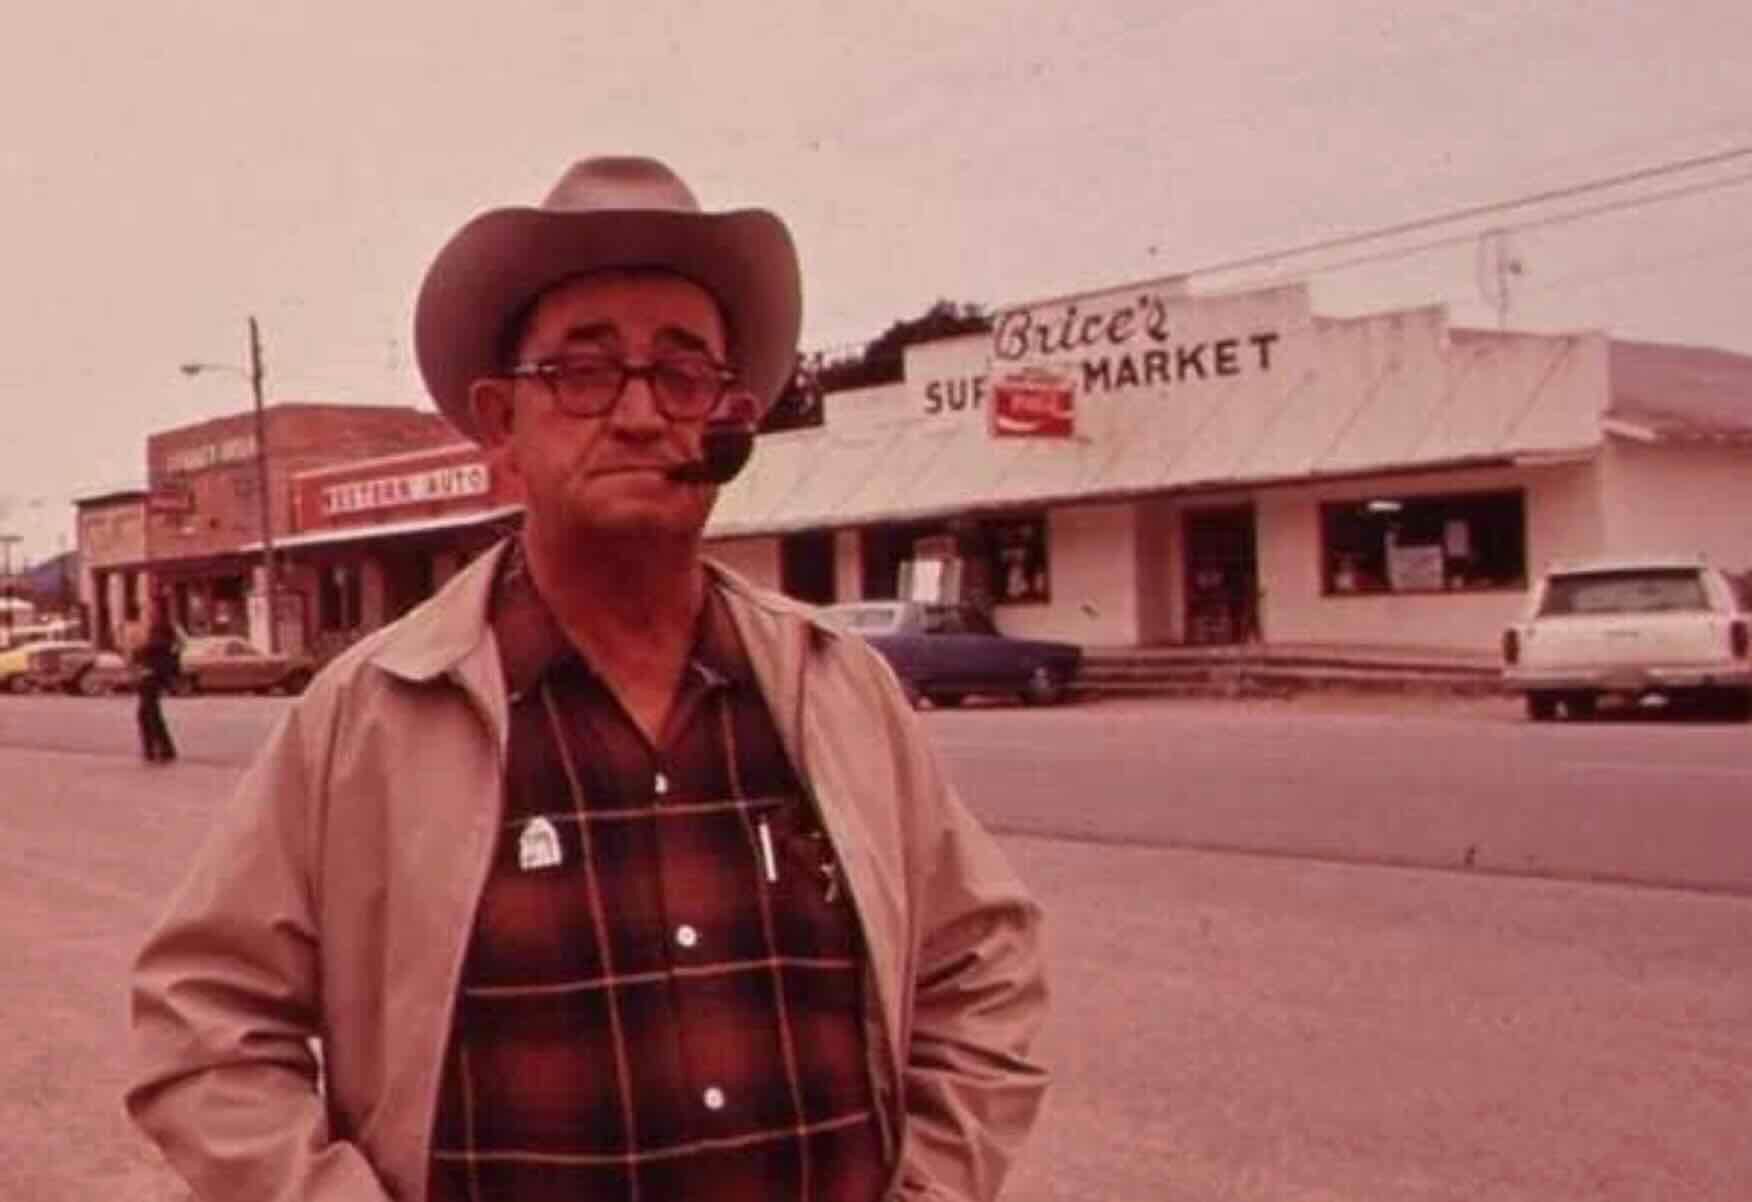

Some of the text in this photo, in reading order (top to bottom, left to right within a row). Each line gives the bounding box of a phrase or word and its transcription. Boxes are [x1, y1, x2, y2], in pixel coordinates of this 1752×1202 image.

[994, 295, 1169, 360] Brice's
[1084, 333, 1279, 392] MARKET
[427, 465, 483, 494] AUTO
